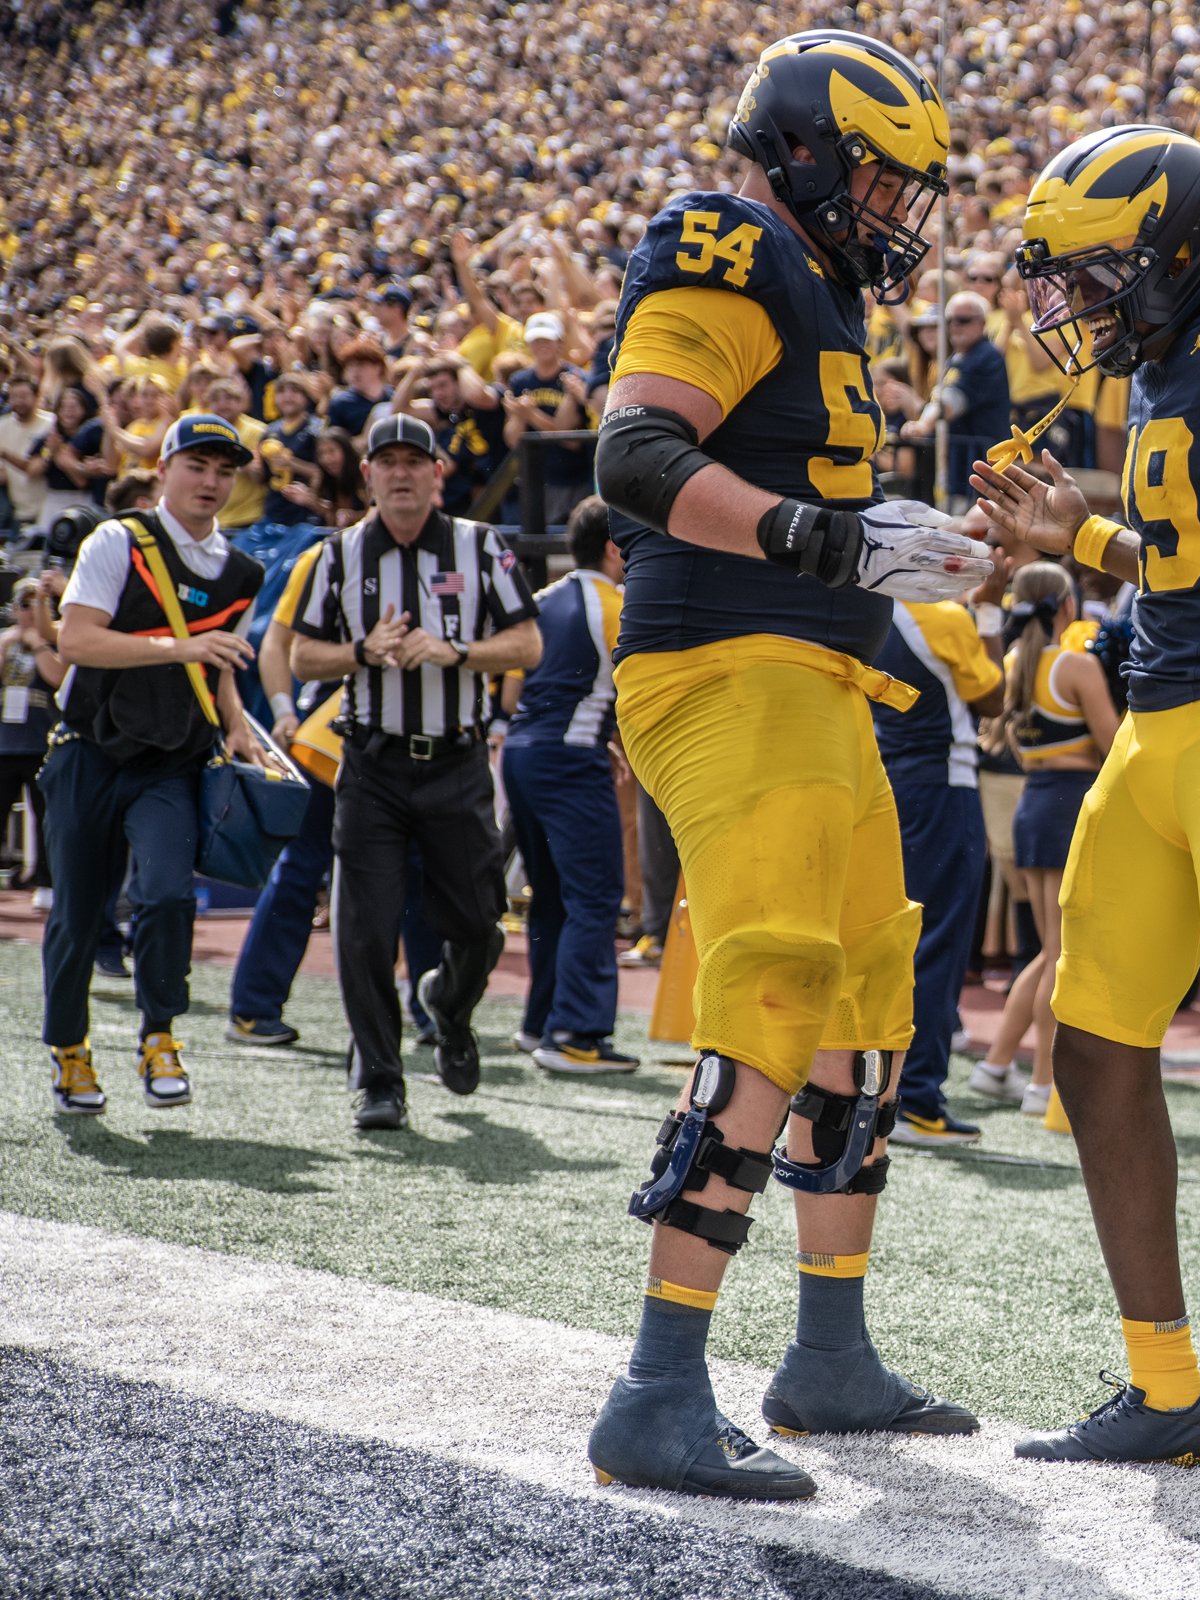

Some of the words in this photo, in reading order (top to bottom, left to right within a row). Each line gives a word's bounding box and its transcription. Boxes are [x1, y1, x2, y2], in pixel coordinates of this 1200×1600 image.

[676, 211, 763, 287] 54
[807, 351, 886, 499] 5
[785, 504, 807, 549] MUELLER
[364, 577, 378, 596] S
[444, 614, 459, 638] F
